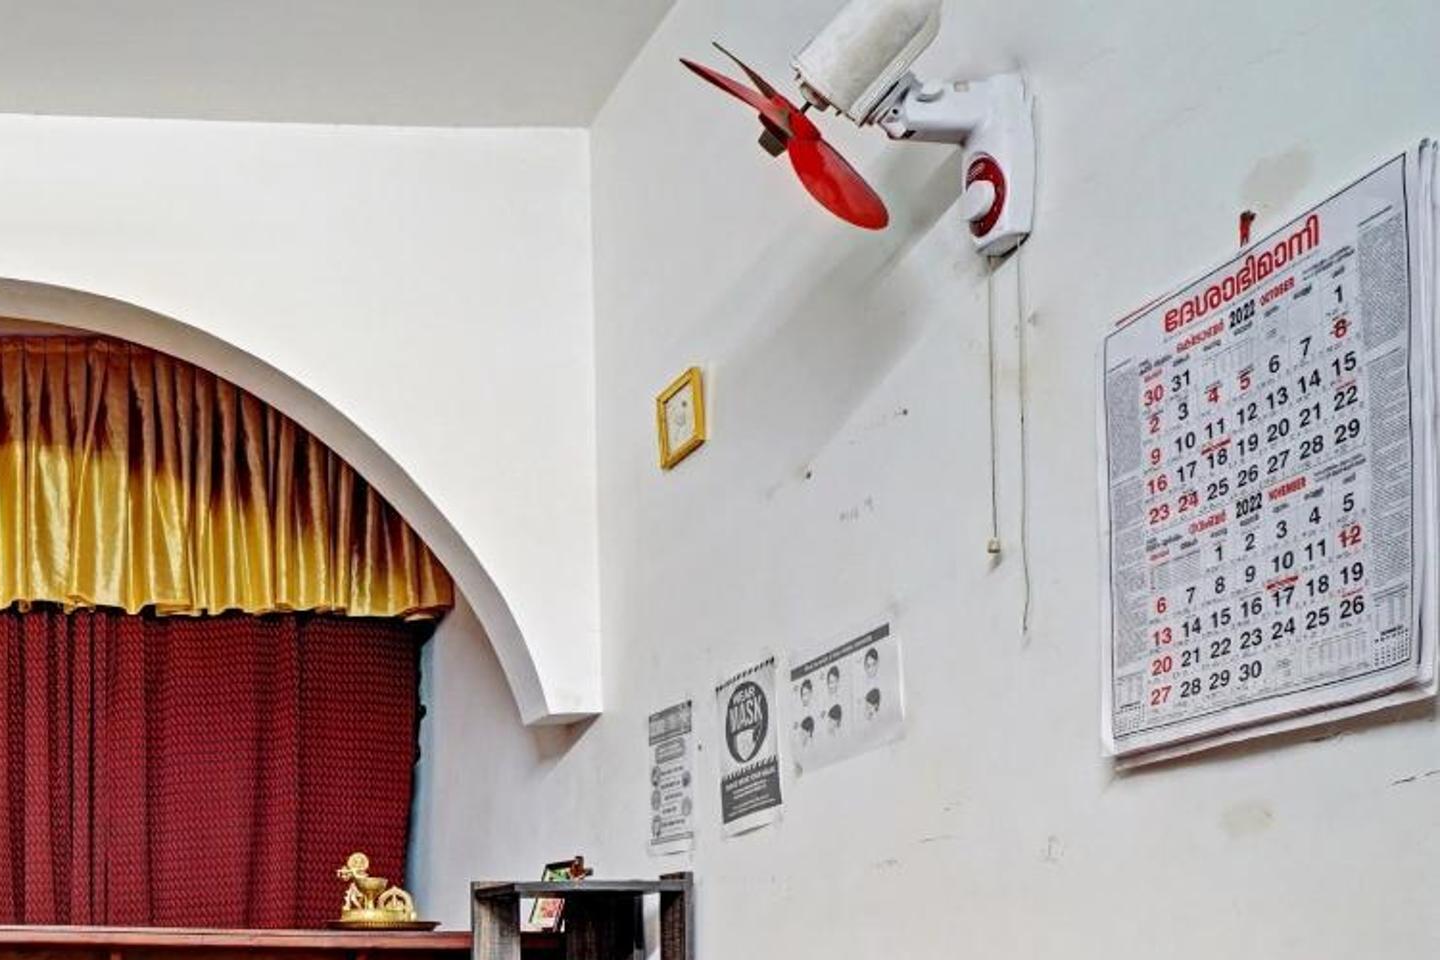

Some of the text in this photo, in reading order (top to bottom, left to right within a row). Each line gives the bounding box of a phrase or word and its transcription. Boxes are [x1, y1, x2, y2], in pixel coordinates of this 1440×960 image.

[1229, 299, 1256, 329] 2022
[1260, 277, 1295, 306] OCTOBER
[1144, 384, 1164, 407] 30
[1171, 370, 1190, 393] 31
[1335, 285, 1343, 303] 1
[1149, 415, 1161, 434] 2
[1178, 402, 1189, 421] 3
[1208, 386, 1220, 403] 4
[1239, 371, 1251, 390] 5
[1268, 354, 1280, 373] 6
[1300, 337, 1312, 358] 7
[1147, 385, 1358, 494] 16 17 18 19 20 21 22
[1151, 351, 1357, 465] 9 10 11 12 13 14 15
[1149, 504, 1170, 524] 23
[1178, 492, 1199, 513] 24
[1207, 478, 1230, 501] 25
[1238, 465, 1259, 488] 26
[1267, 450, 1290, 474] 27
[1300, 435, 1324, 460] 28
[1334, 418, 1360, 445] 29
[1236, 493, 1262, 519] 2022
[1268, 476, 1307, 500] NOVEMBER
[1215, 547, 1223, 561] 1
[1245, 533, 1255, 551] 2
[1276, 520, 1288, 539] 3
[1309, 507, 1321, 524] 4
[1343, 492, 1354, 512] 5
[1153, 562, 1364, 646] 13 14 15 16 17 18 19
[1157, 597, 1167, 614] 6
[1186, 587, 1196, 603] 7
[1245, 566, 1256, 583] 9
[1272, 551, 1294, 573] 10
[1305, 539, 1326, 561] 11
[1152, 656, 1172, 676] 20
[1181, 648, 1200, 668] 21
[1210, 637, 1231, 659] 22
[1240, 628, 1262, 650] 23
[1272, 617, 1295, 640] 24
[1306, 607, 1330, 630] 25
[1340, 595, 1364, 619] 26
[729, 694, 763, 733] MASK
[1151, 660, 1262, 706] 27 28 29 30
